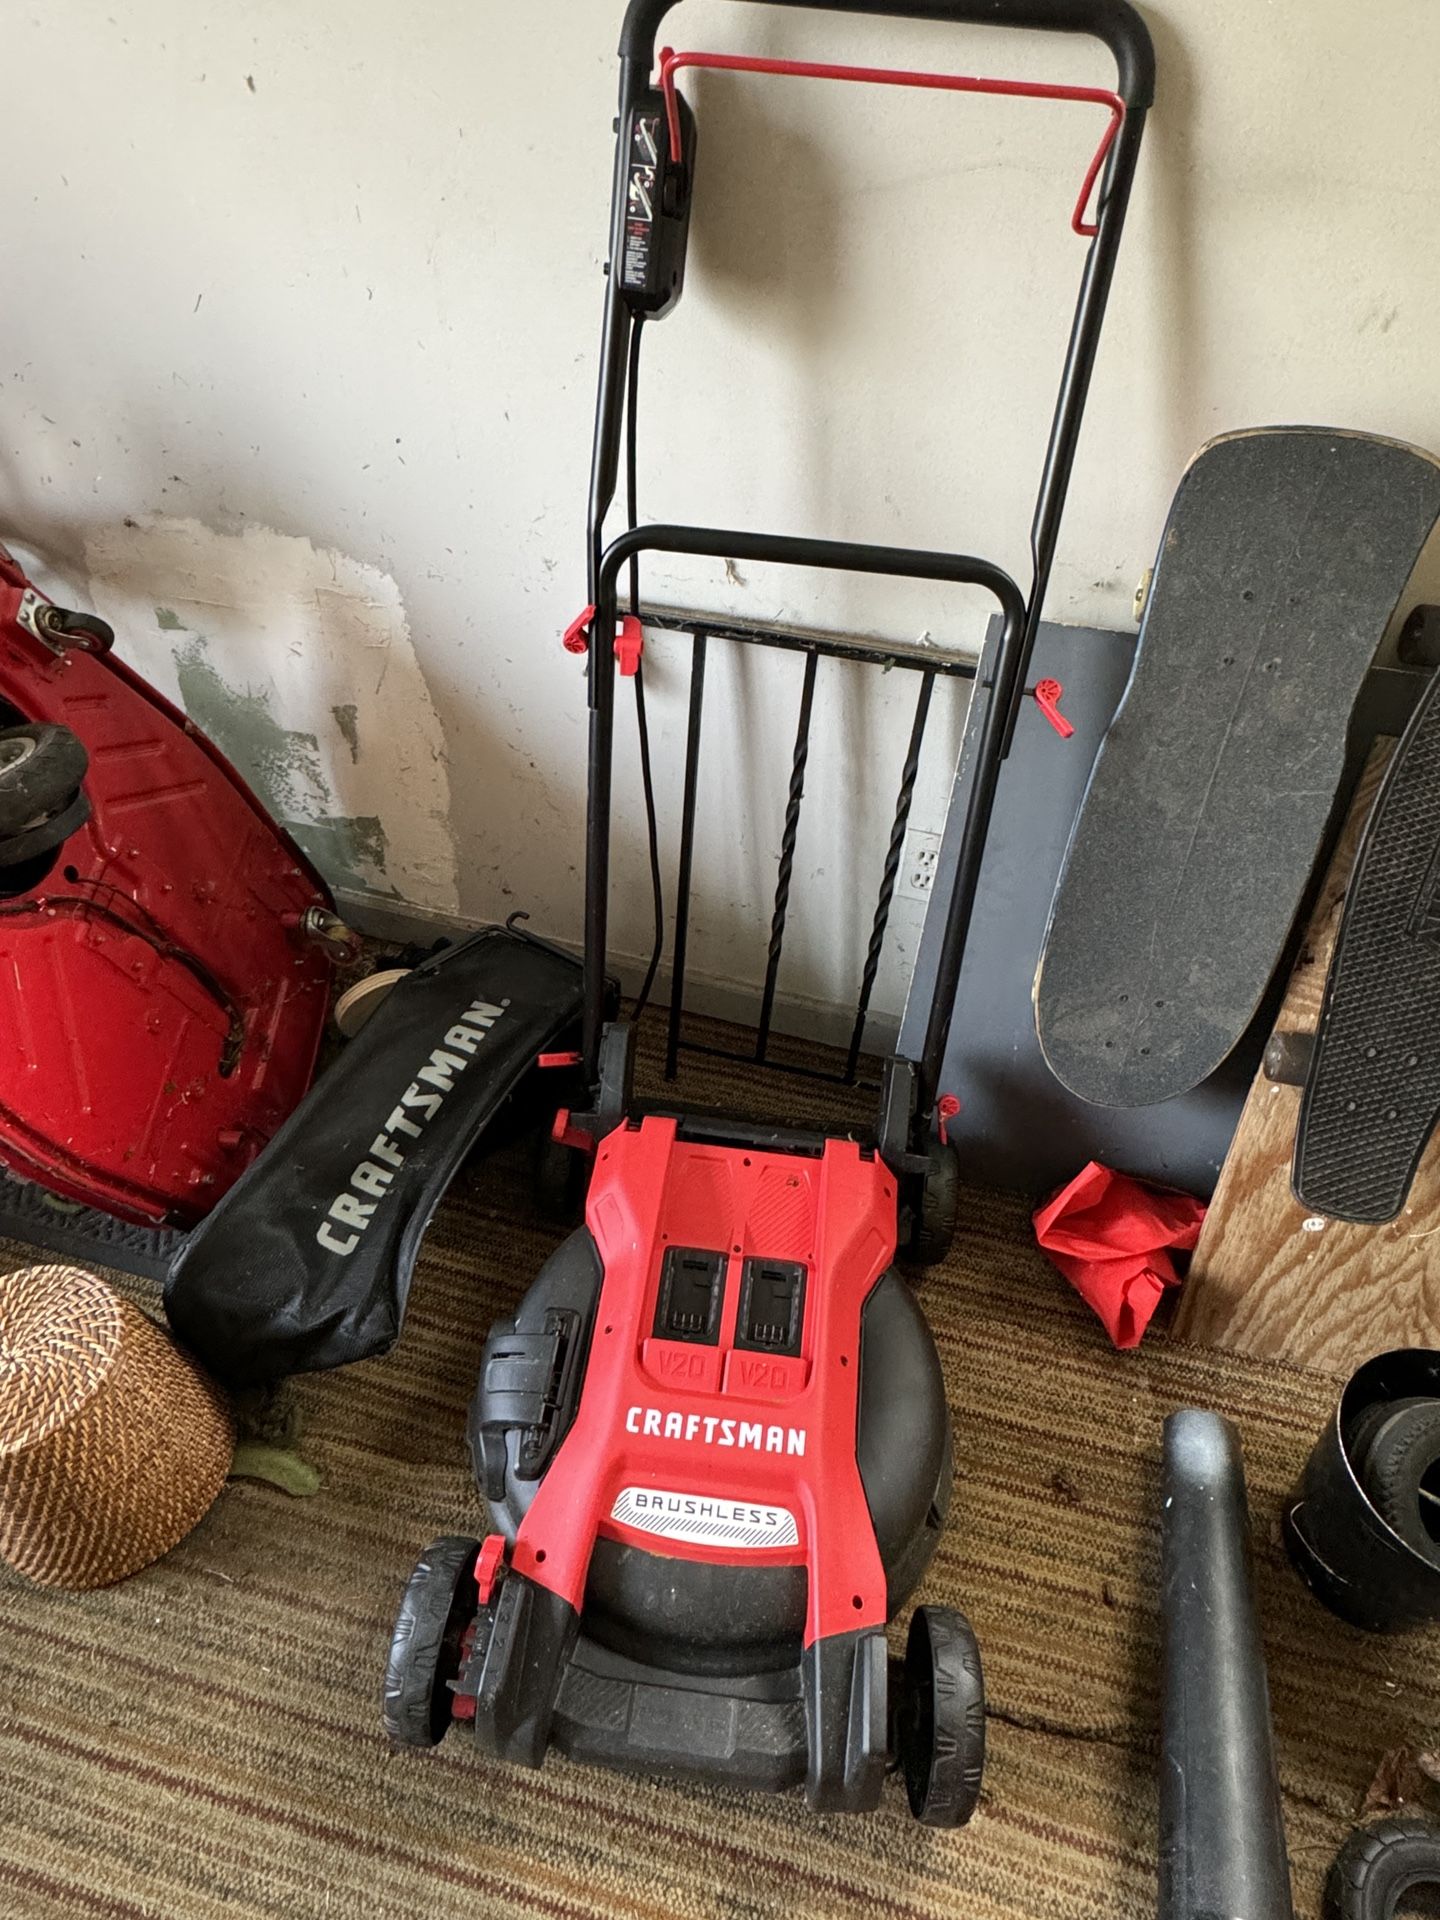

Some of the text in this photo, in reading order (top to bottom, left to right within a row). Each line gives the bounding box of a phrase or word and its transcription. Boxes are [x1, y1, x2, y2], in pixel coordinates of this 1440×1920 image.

[316, 1000, 505, 1257] CRAFTSMAN
[659, 1350, 705, 1378] V20
[739, 1360, 790, 1391] V20
[625, 1406, 806, 1456] CRAFTSMAN
[635, 1494, 778, 1526] BRUSHLESS
